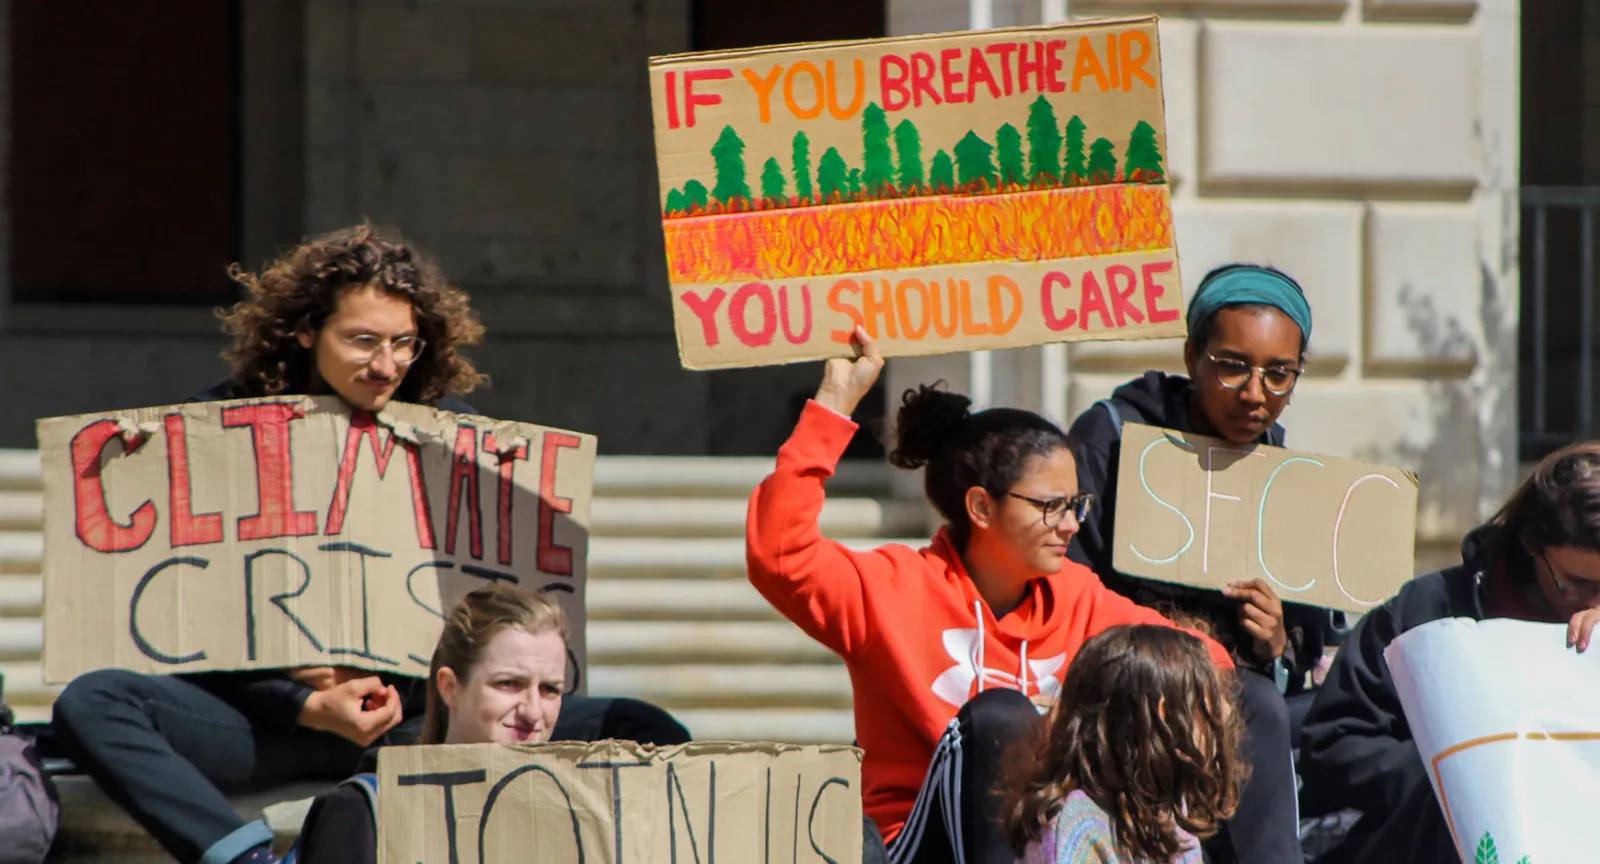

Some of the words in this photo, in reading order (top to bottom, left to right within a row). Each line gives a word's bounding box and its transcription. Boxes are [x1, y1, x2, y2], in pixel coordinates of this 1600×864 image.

[664, 68, 734, 129] IF
[742, 59, 865, 124] YOU
[879, 40, 1067, 111] BREATHE
[1071, 30, 1157, 93] AIR
[680, 282, 812, 348] YOU
[826, 275, 1023, 343] SHOULD
[1040, 261, 1181, 332] CARE
[69, 401, 581, 577] CLIMATE
[1129, 436, 1401, 607] SFCC
[129, 541, 580, 695] CRIS
[397, 760, 716, 864] JOIN
[765, 766, 850, 864] US
